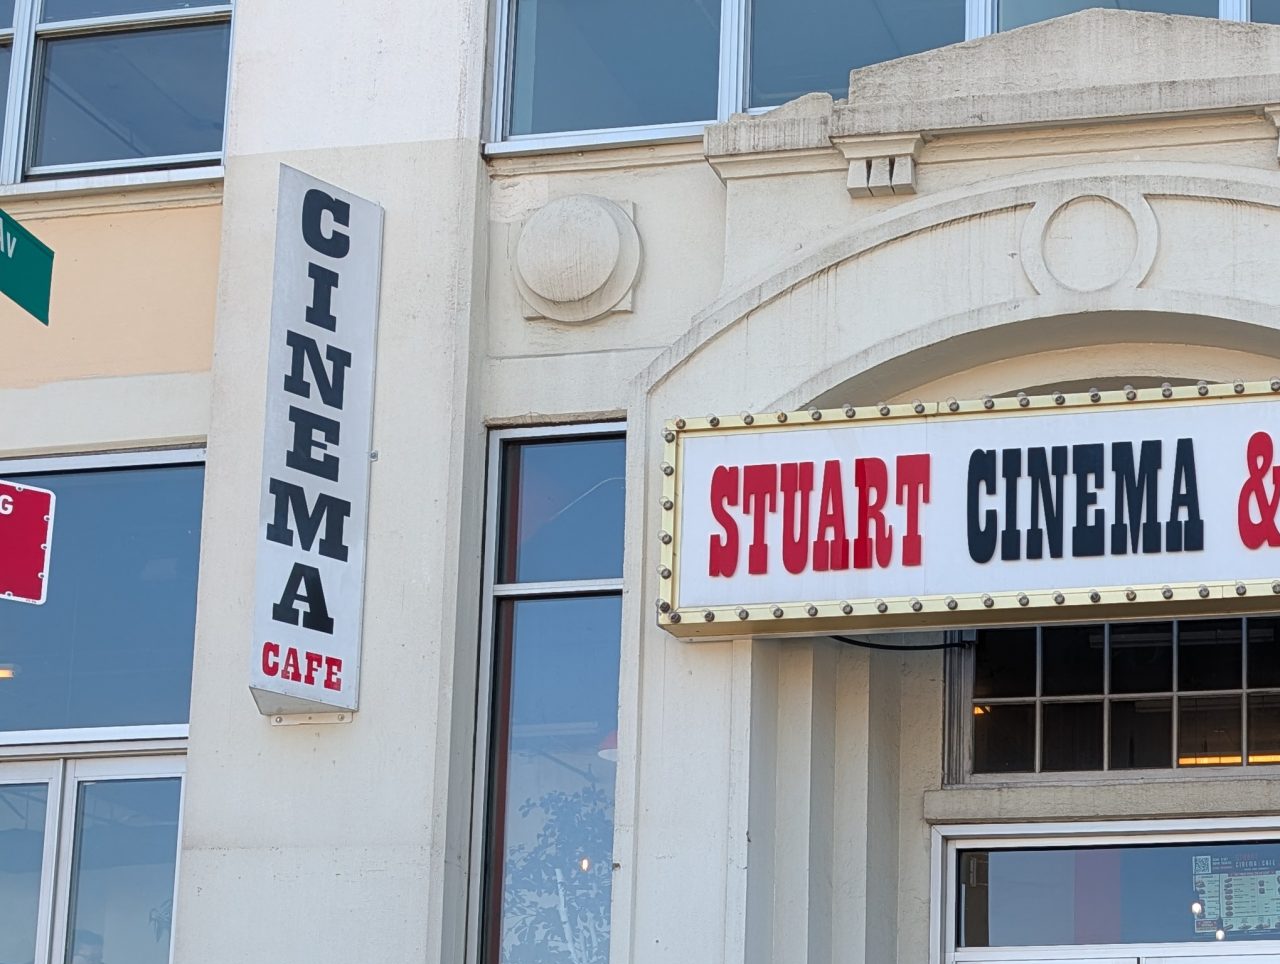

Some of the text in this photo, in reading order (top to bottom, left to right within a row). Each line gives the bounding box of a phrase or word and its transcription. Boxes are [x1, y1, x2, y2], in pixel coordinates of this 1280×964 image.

[266, 188, 352, 635] CINEMA
[709, 454, 930, 578] STUART
[967, 437, 1205, 564] CINEMA
[262, 641, 343, 690] CAFE
